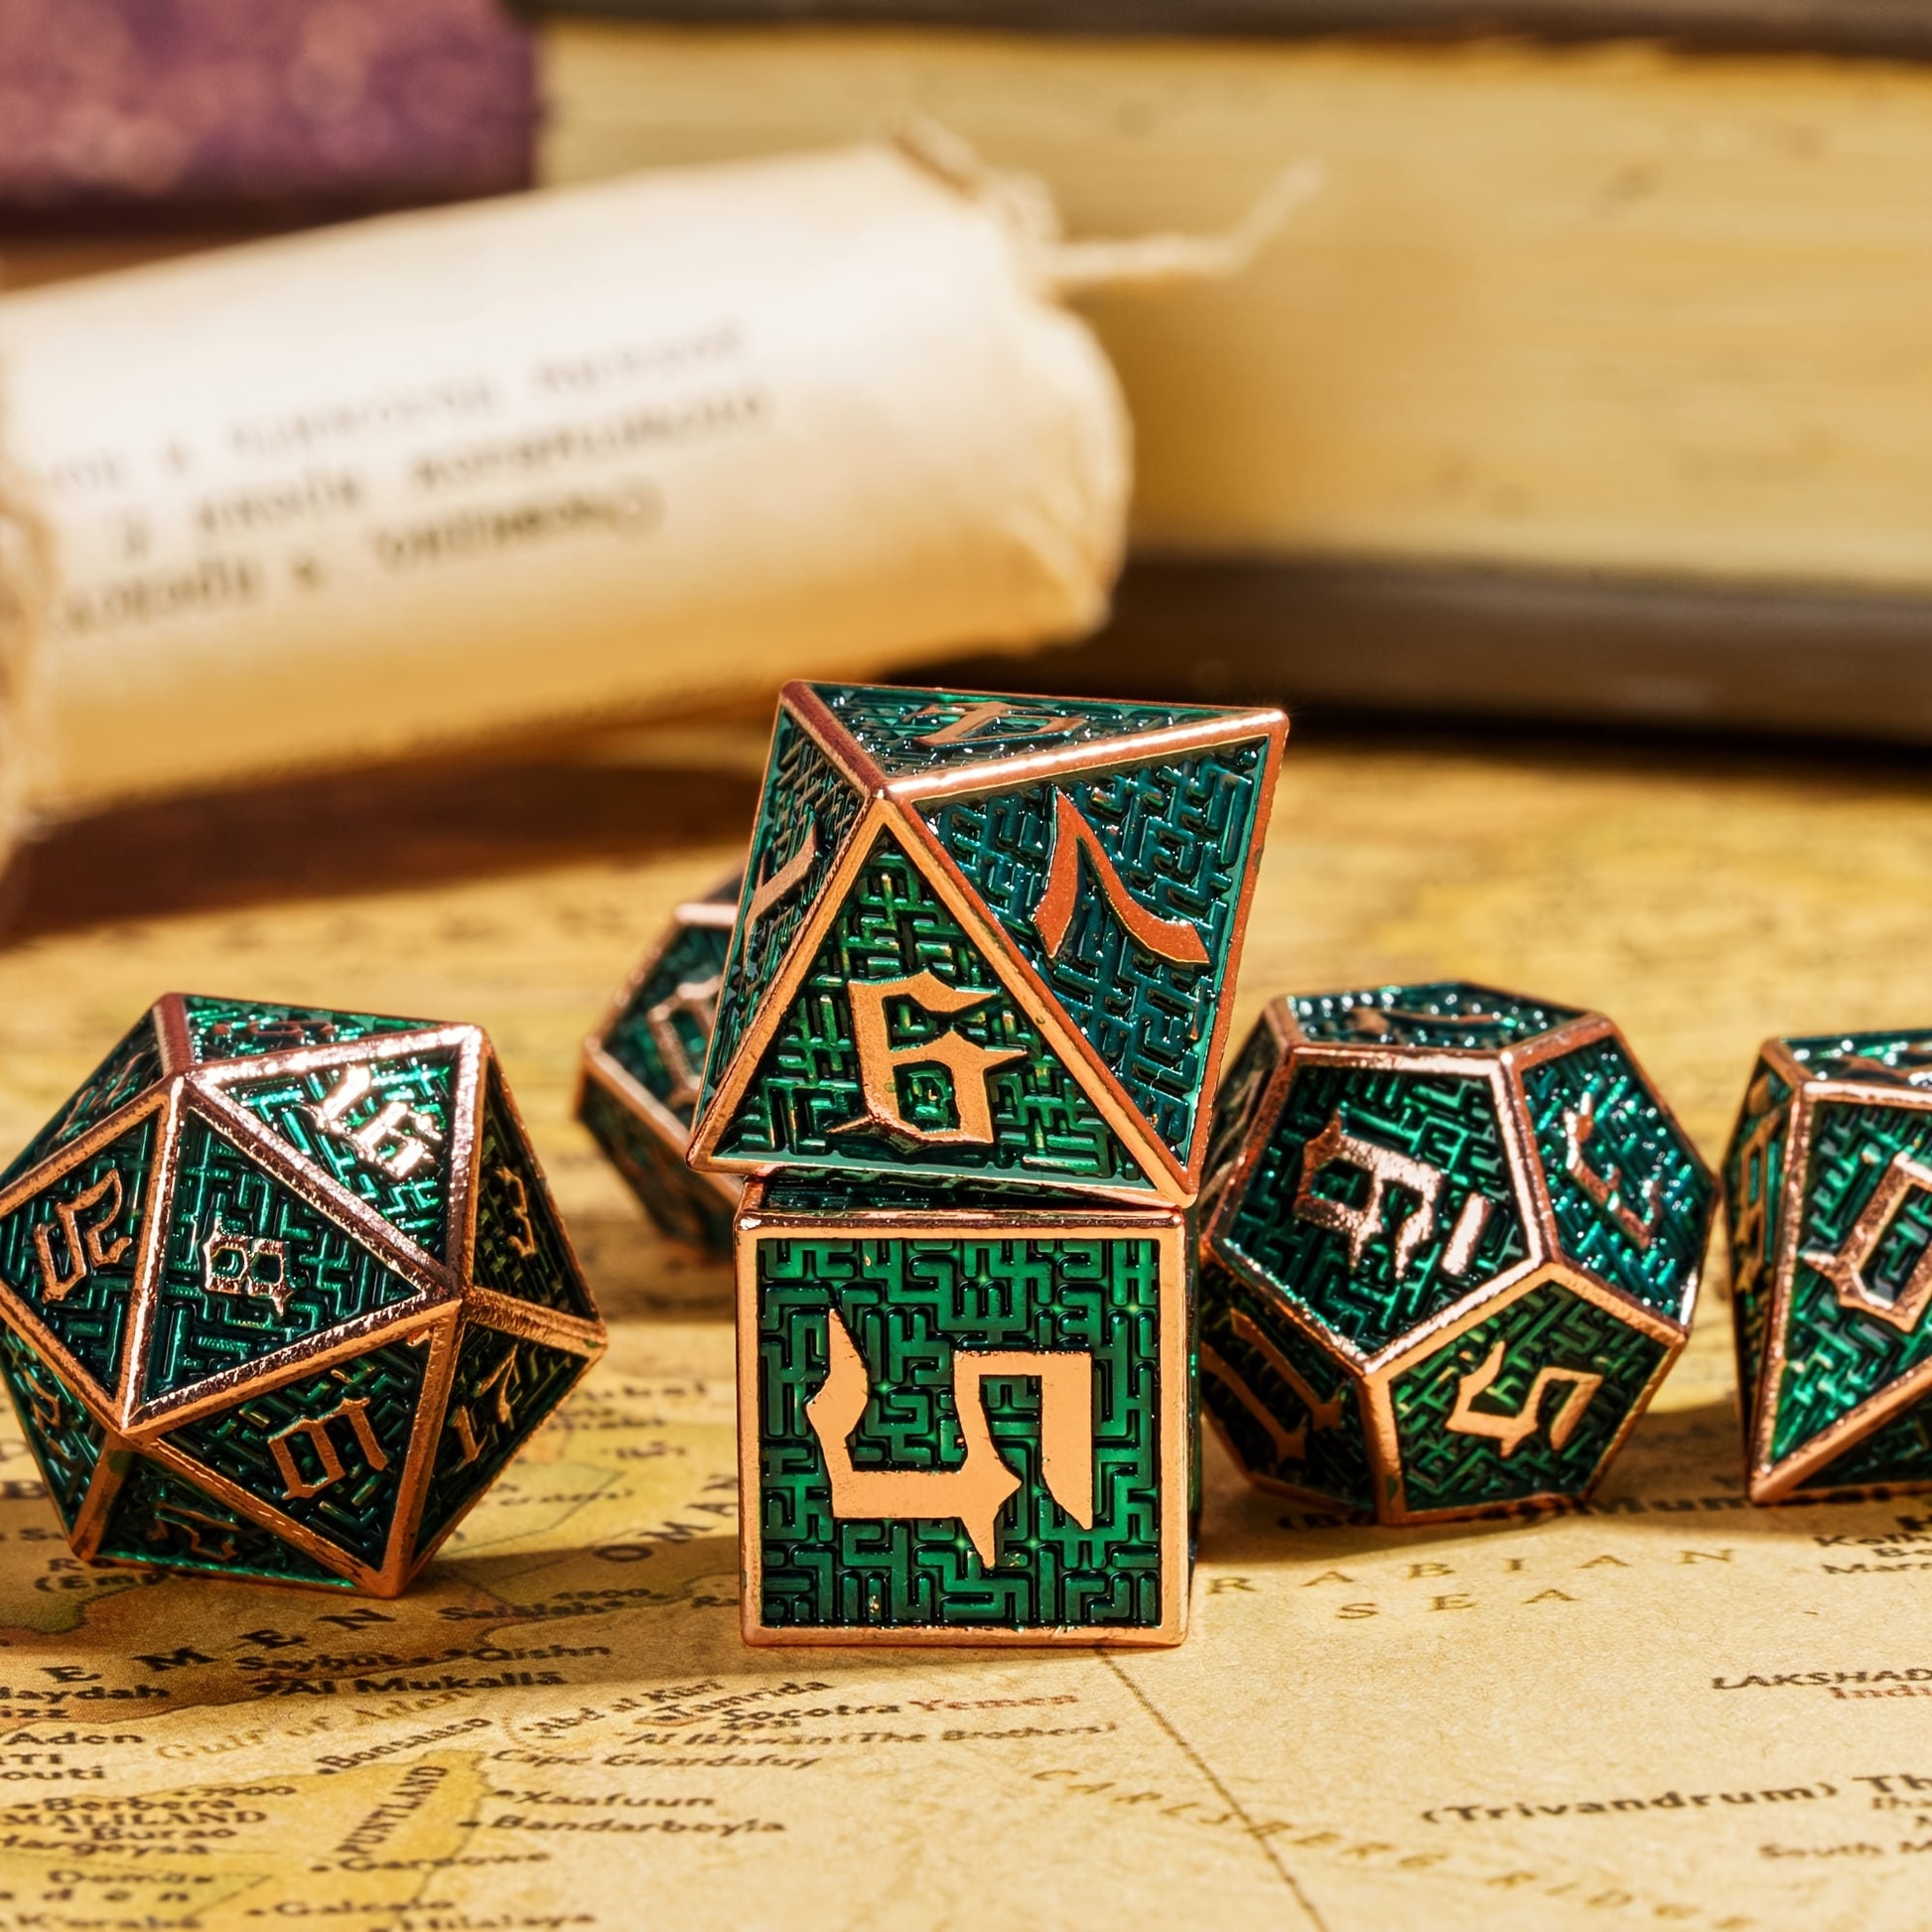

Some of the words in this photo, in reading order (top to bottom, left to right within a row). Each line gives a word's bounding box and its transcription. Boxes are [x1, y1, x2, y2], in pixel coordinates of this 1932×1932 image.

[826, 970, 1028, 1150] 6
[203, 1218, 294, 1320] 8
[1334, 1588, 1581, 1621] SEA
[721, 1704, 901, 1723] Socotra
[908, 1694, 1079, 1713] Yemen
[0, 1753, 62, 1765] TI
[1422, 1781, 1839, 1825] (Trivandrum)
